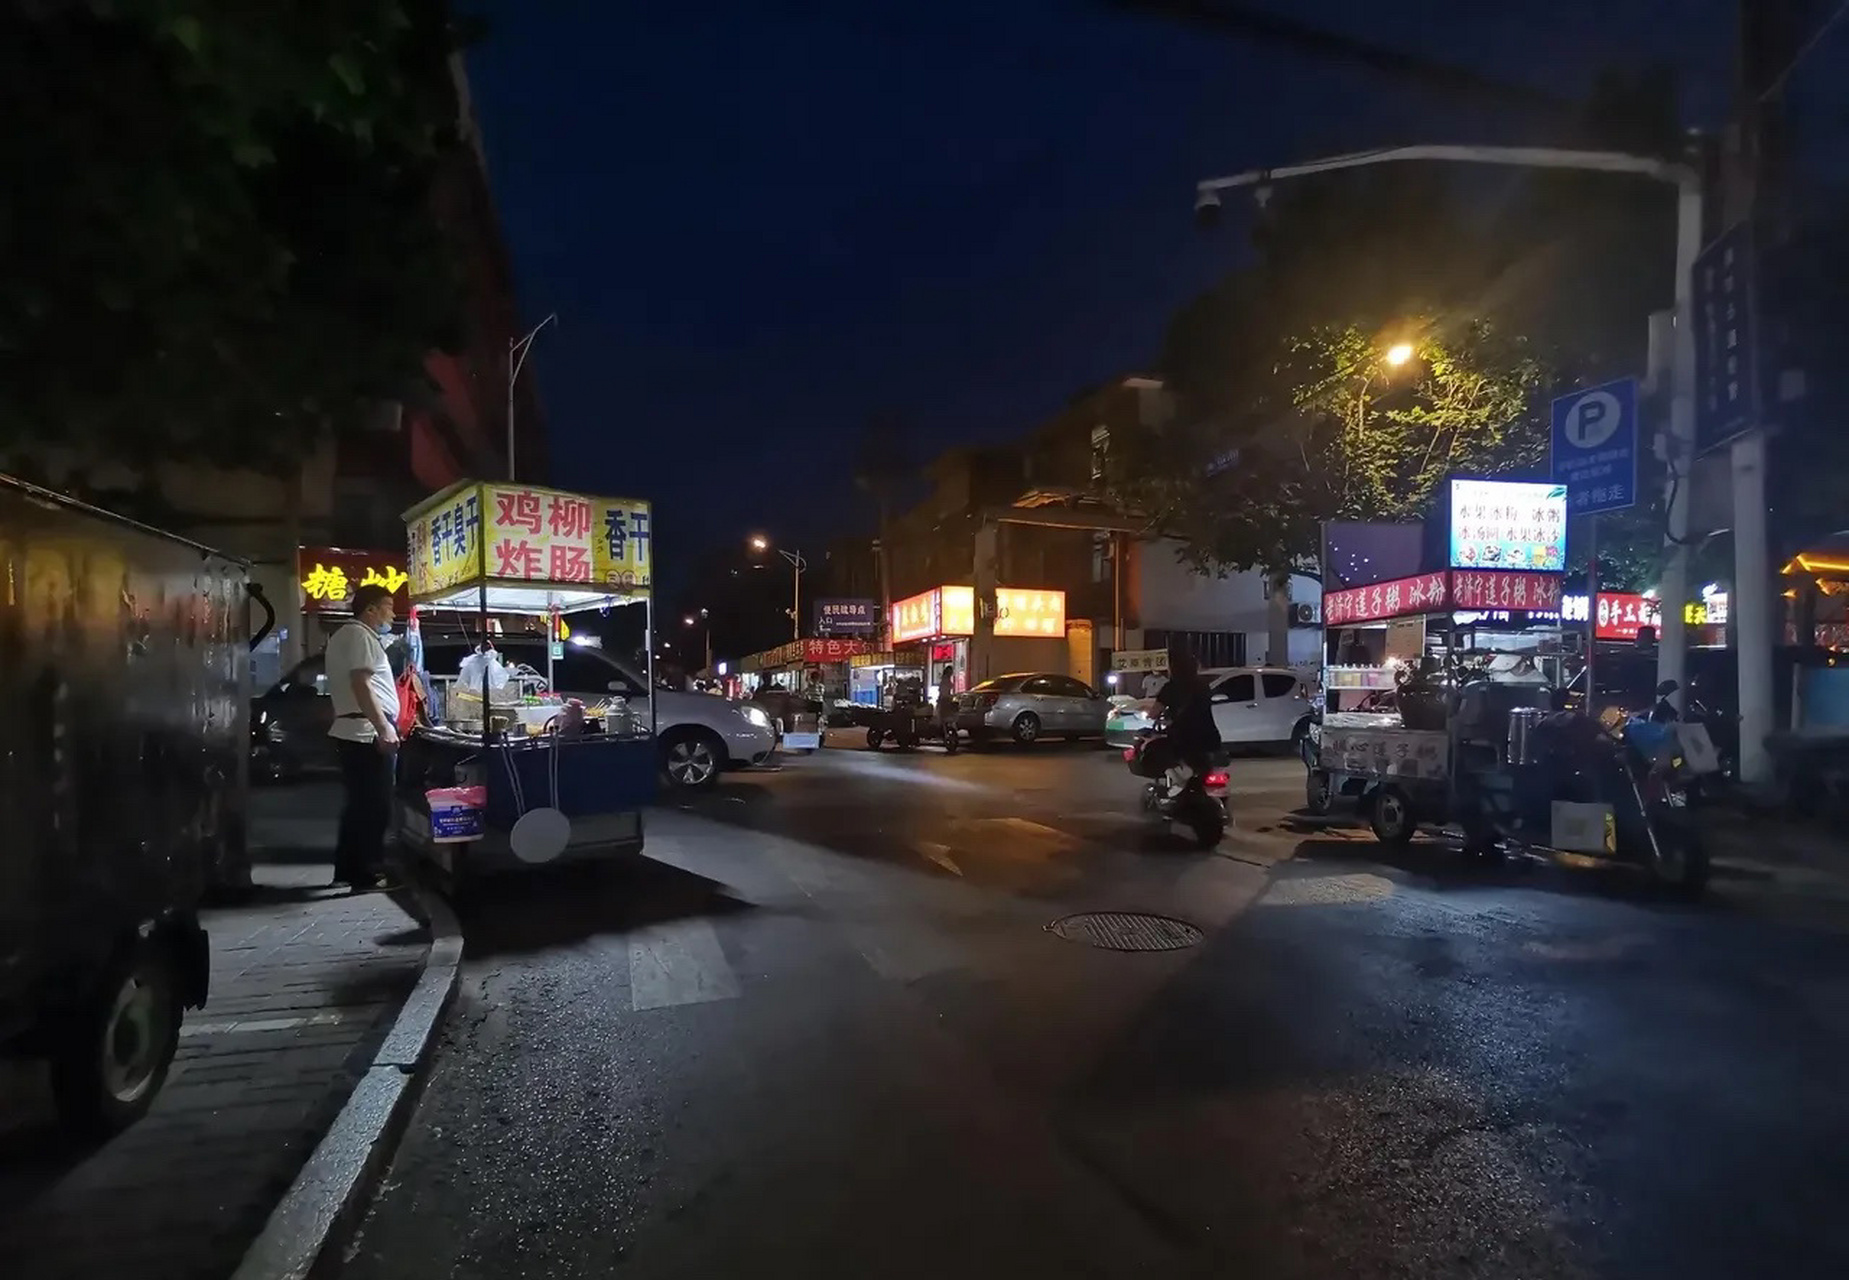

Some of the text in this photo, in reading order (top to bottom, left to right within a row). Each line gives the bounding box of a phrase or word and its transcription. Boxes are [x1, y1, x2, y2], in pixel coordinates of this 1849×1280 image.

[431, 496, 479, 566] 香干臭干
[495, 490, 592, 540] 鸡柳
[605, 509, 650, 562] 香干
[495, 539, 592, 583] 炸肠
